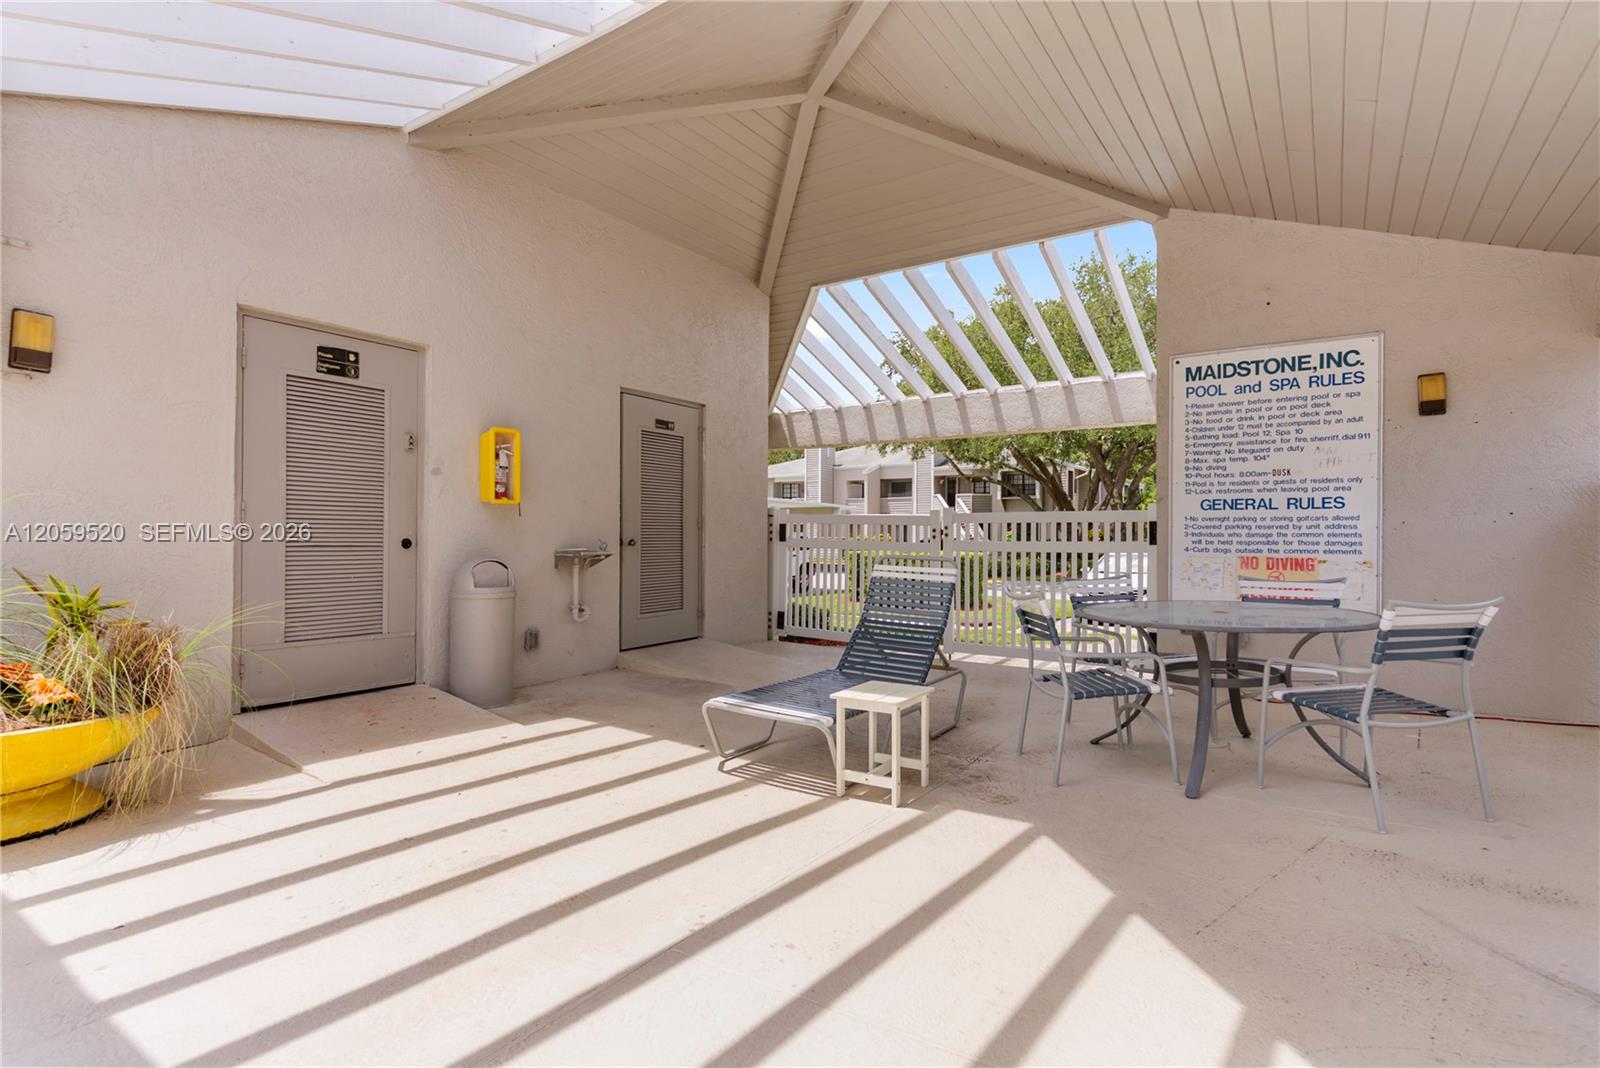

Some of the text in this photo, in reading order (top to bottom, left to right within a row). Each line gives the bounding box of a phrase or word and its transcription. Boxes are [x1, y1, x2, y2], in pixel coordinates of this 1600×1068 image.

[1186, 370, 1366, 399] POOL and SPA RULES
[1185, 402, 1214, 410] 1-Please
[1218, 400, 1244, 408] shower
[1248, 397, 1272, 405] before
[1276, 395, 1308, 404] entering
[1311, 393, 1329, 401] pool
[1345, 391, 1361, 399] spa
[1206, 408, 1232, 416] animals
[1245, 406, 1262, 414] pool
[1290, 403, 1308, 411] pool
[1311, 401, 1331, 409] deck
[1185, 418, 1203, 426] 3-No
[1268, 413, 1285, 421] pool
[1300, 410, 1320, 418] deck
[1185, 426, 1215, 434] 4-Children
[1276, 419, 1321, 428] accompanied
[1323, 418, 1332, 426] by
[1185, 433, 1220, 442] 5-Bathing
[1275, 429, 1291, 437] Spa
[1185, 440, 1233, 450] 6-Emergency
[1236, 438, 1277, 446] assistance
[1238, 446, 1270, 455] lifeguard
[1286, 445, 1305, 453] duty
[1205, 464, 1227, 472] diving
[1229, 479, 1260, 487] residents
[1273, 478, 1297, 486] guests
[1347, 476, 1363, 484] only
[1281, 486, 1308, 494] leaving
[1311, 485, 1330, 493] pool
[1200, 496, 1345, 511] GENERAL RULES
